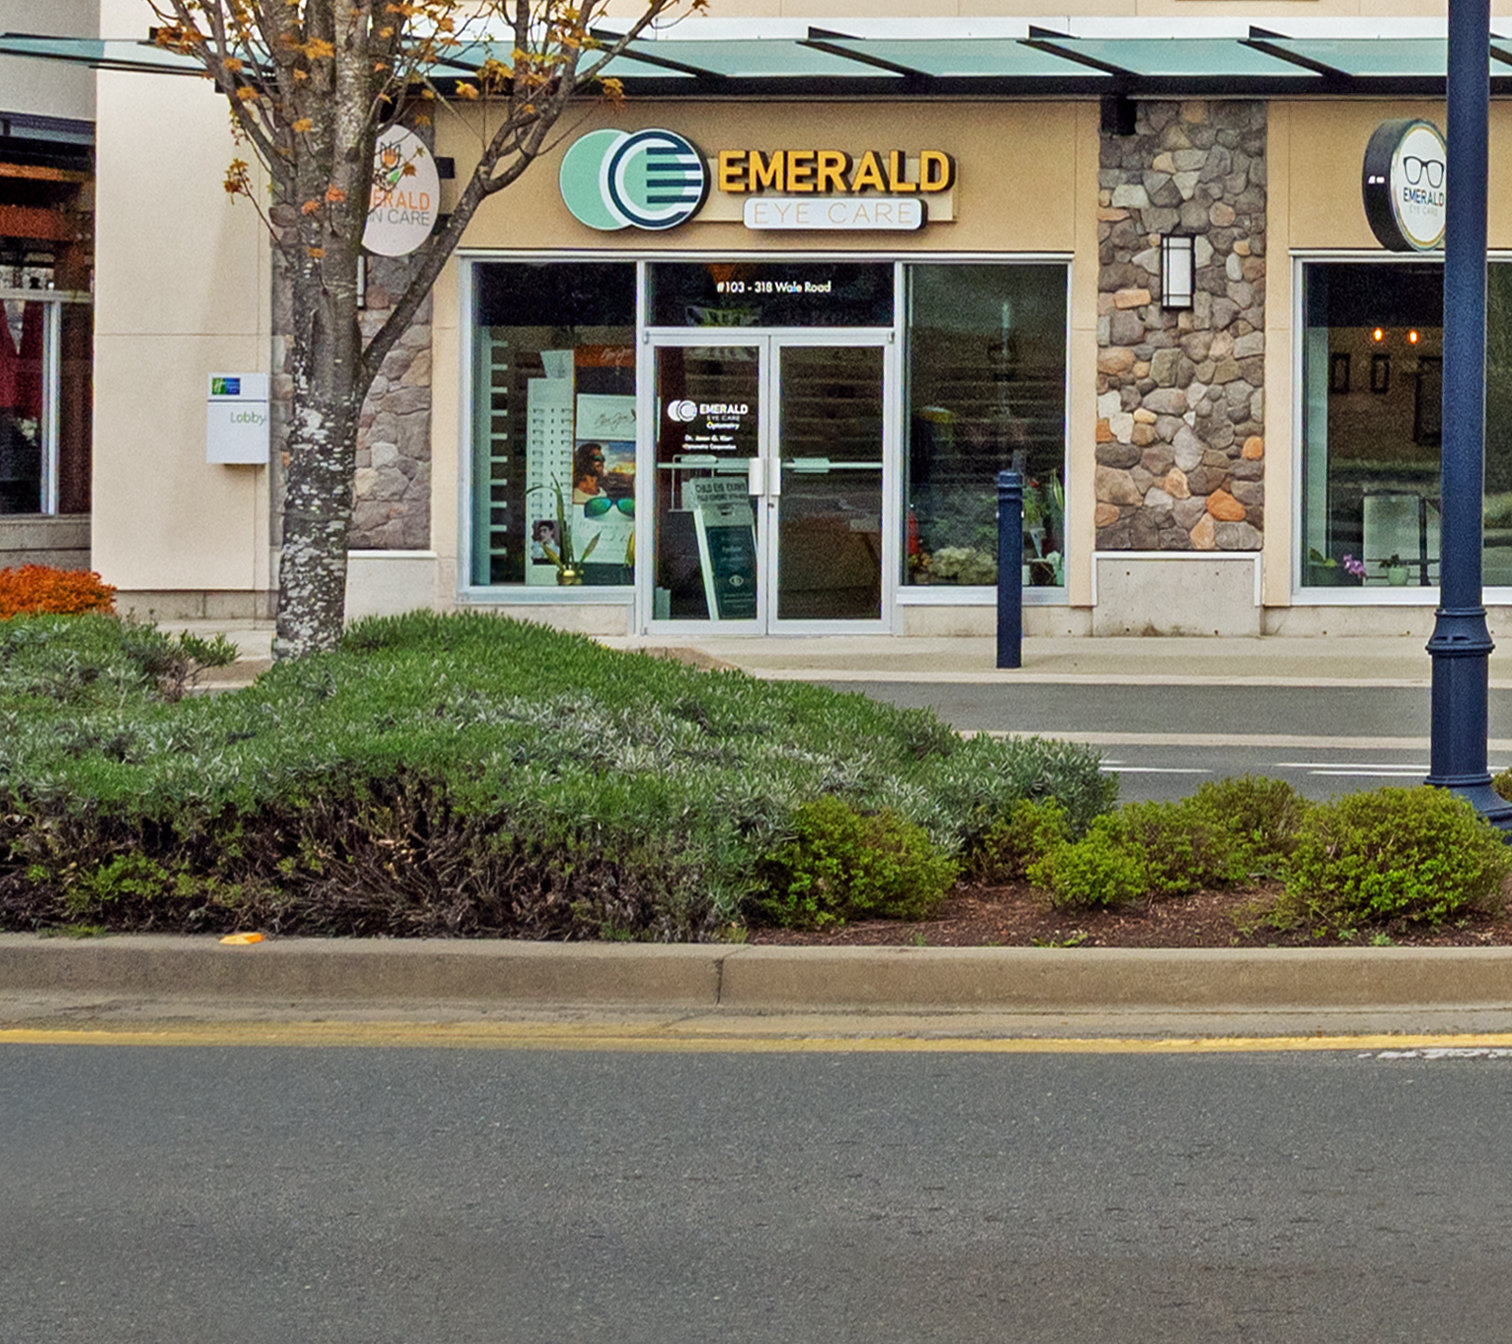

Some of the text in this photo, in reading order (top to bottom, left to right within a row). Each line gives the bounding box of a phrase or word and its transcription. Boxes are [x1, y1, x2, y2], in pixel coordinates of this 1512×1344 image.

[717, 149, 954, 194] EMERALD
[372, 188, 430, 211] ERALD
[1403, 187, 1445, 207] EMERALD
[387, 209, 430, 227] CARE
[753, 201, 914, 225] EYE CARE
[716, 280, 745, 293] #103
[754, 280, 773, 293] 318
[775, 280, 803, 293] Wale
[804, 280, 832, 293] Road
[229, 411, 266, 426] Lobby
[699, 403, 749, 416] EMERALD
